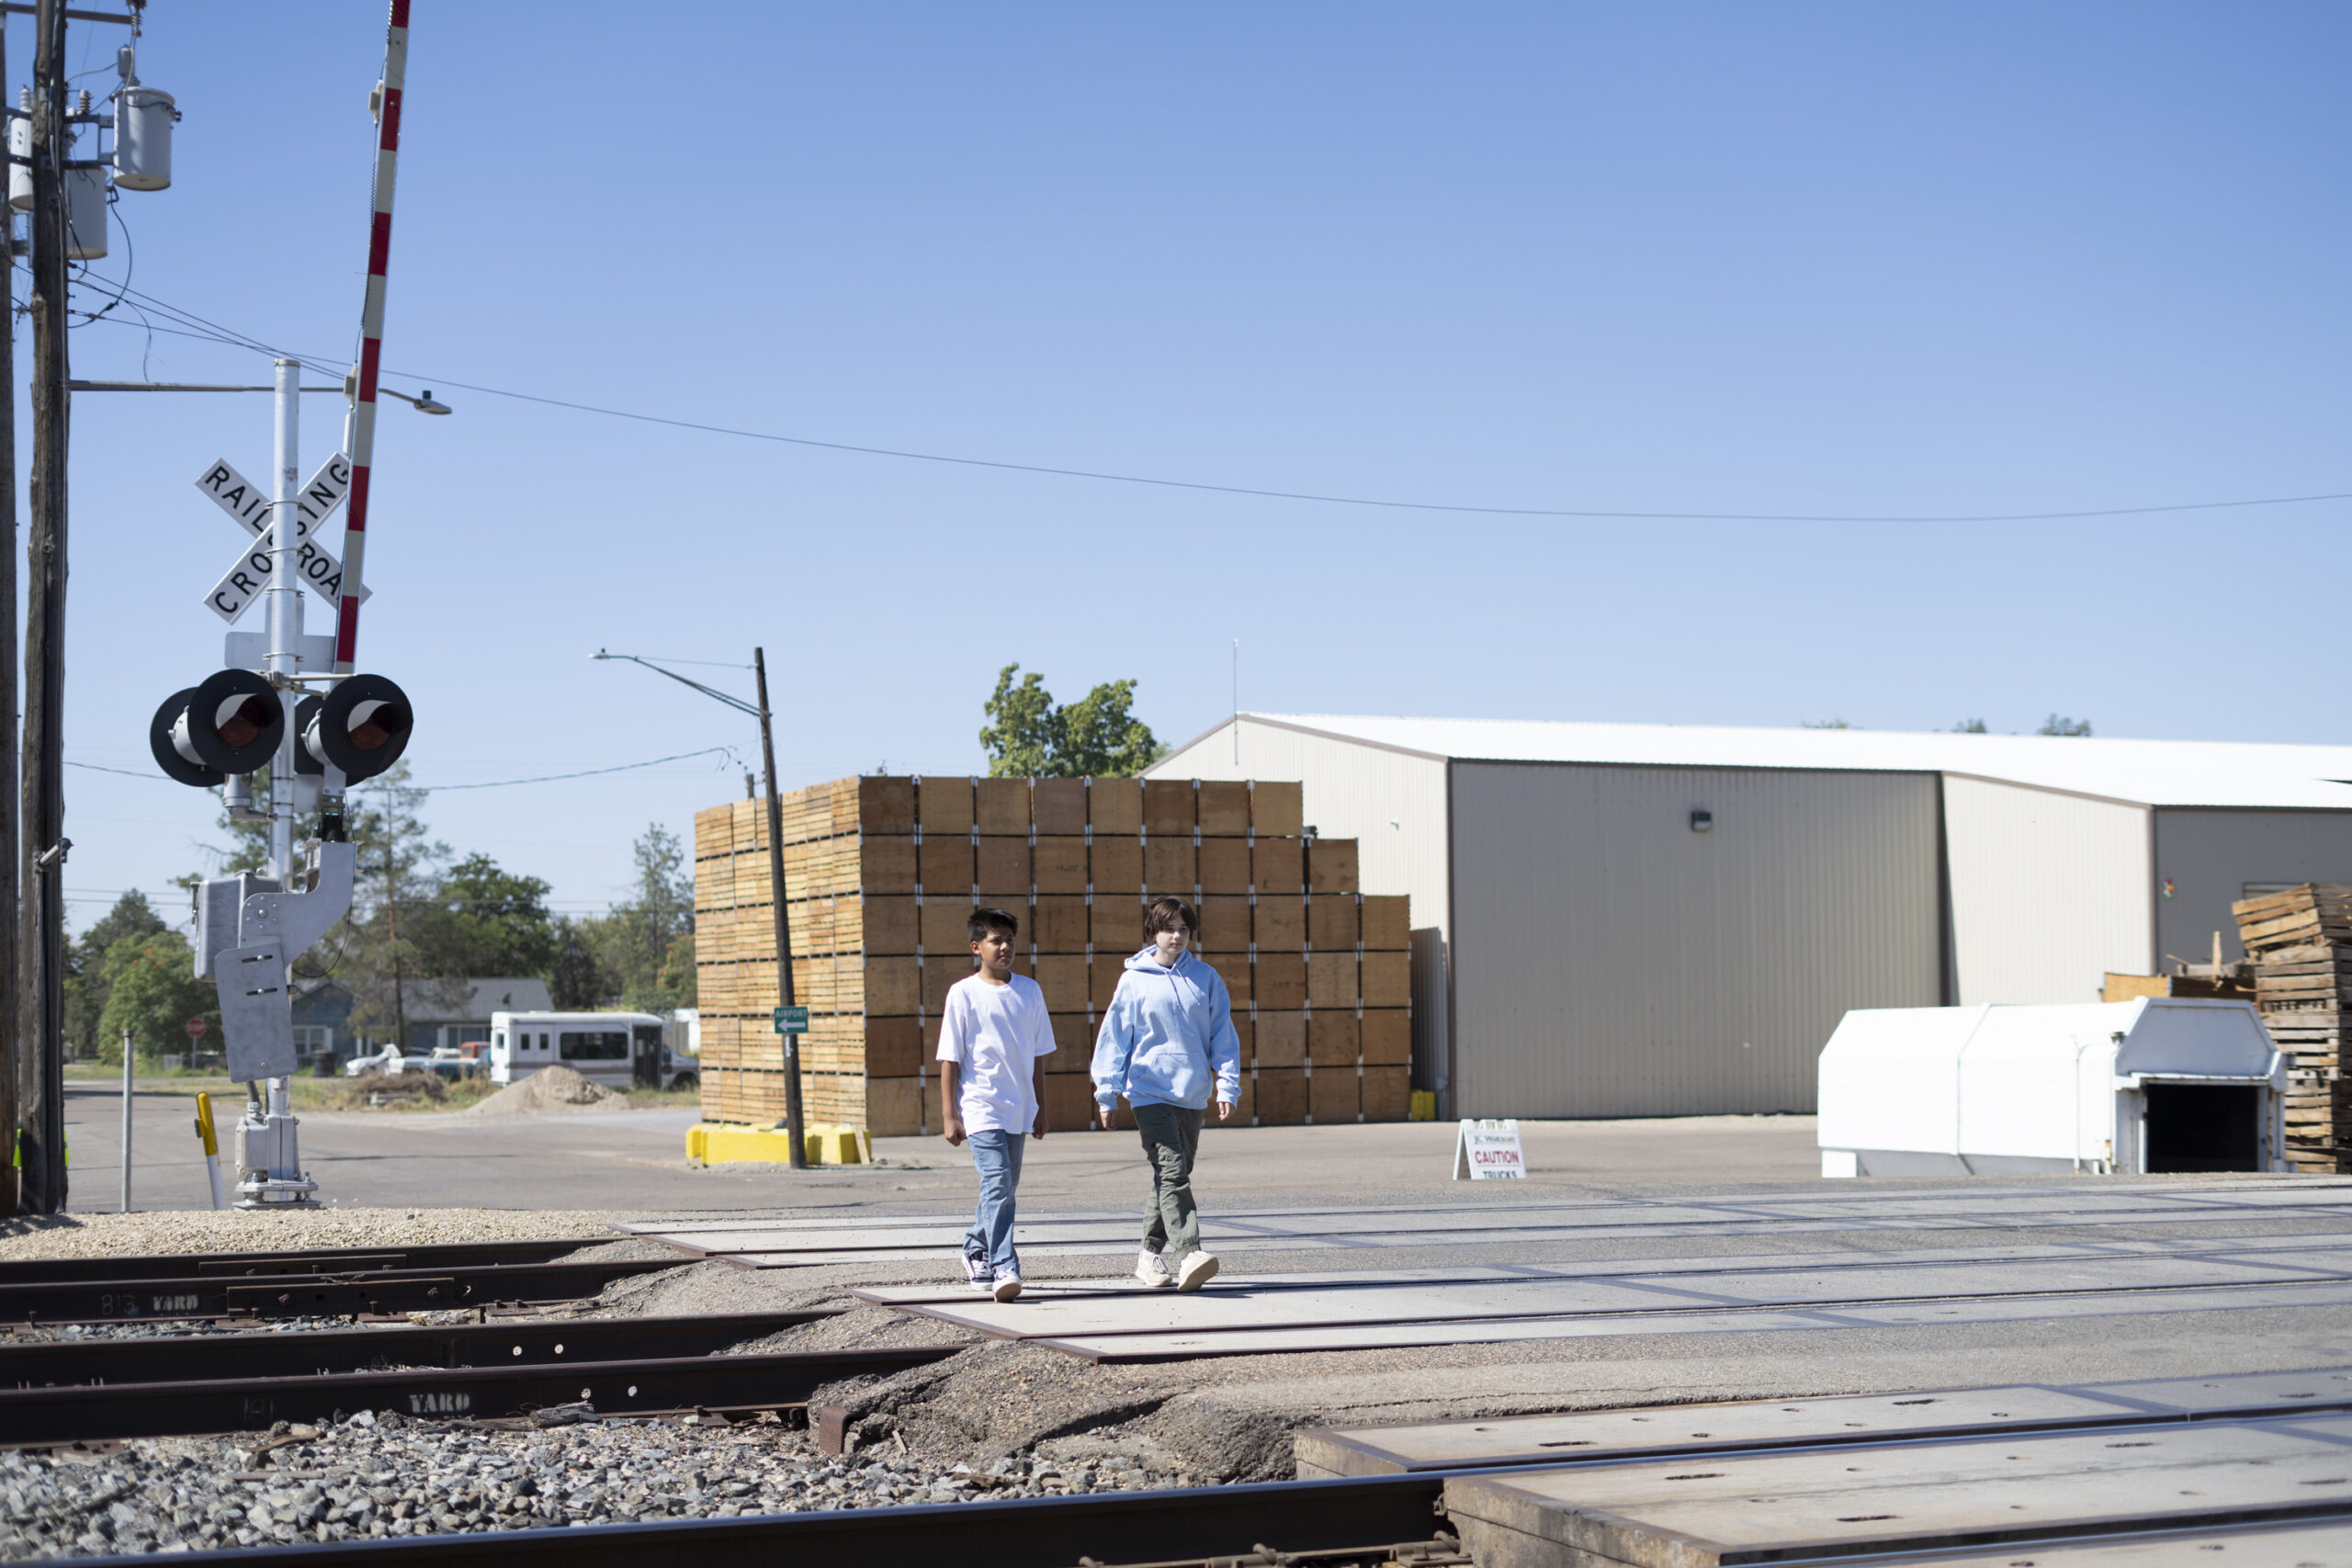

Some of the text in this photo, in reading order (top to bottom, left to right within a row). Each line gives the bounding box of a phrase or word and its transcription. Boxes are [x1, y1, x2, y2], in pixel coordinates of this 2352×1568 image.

[205, 465, 342, 600] RAILROA
[775, 1009, 807, 1018] AIRPORT
[1475, 1150, 1520, 1165] CAUTION
[1483, 1169, 1518, 1180] TRUCKS
[153, 1294, 198, 1312] YARD
[409, 1393, 470, 1414] YARD
